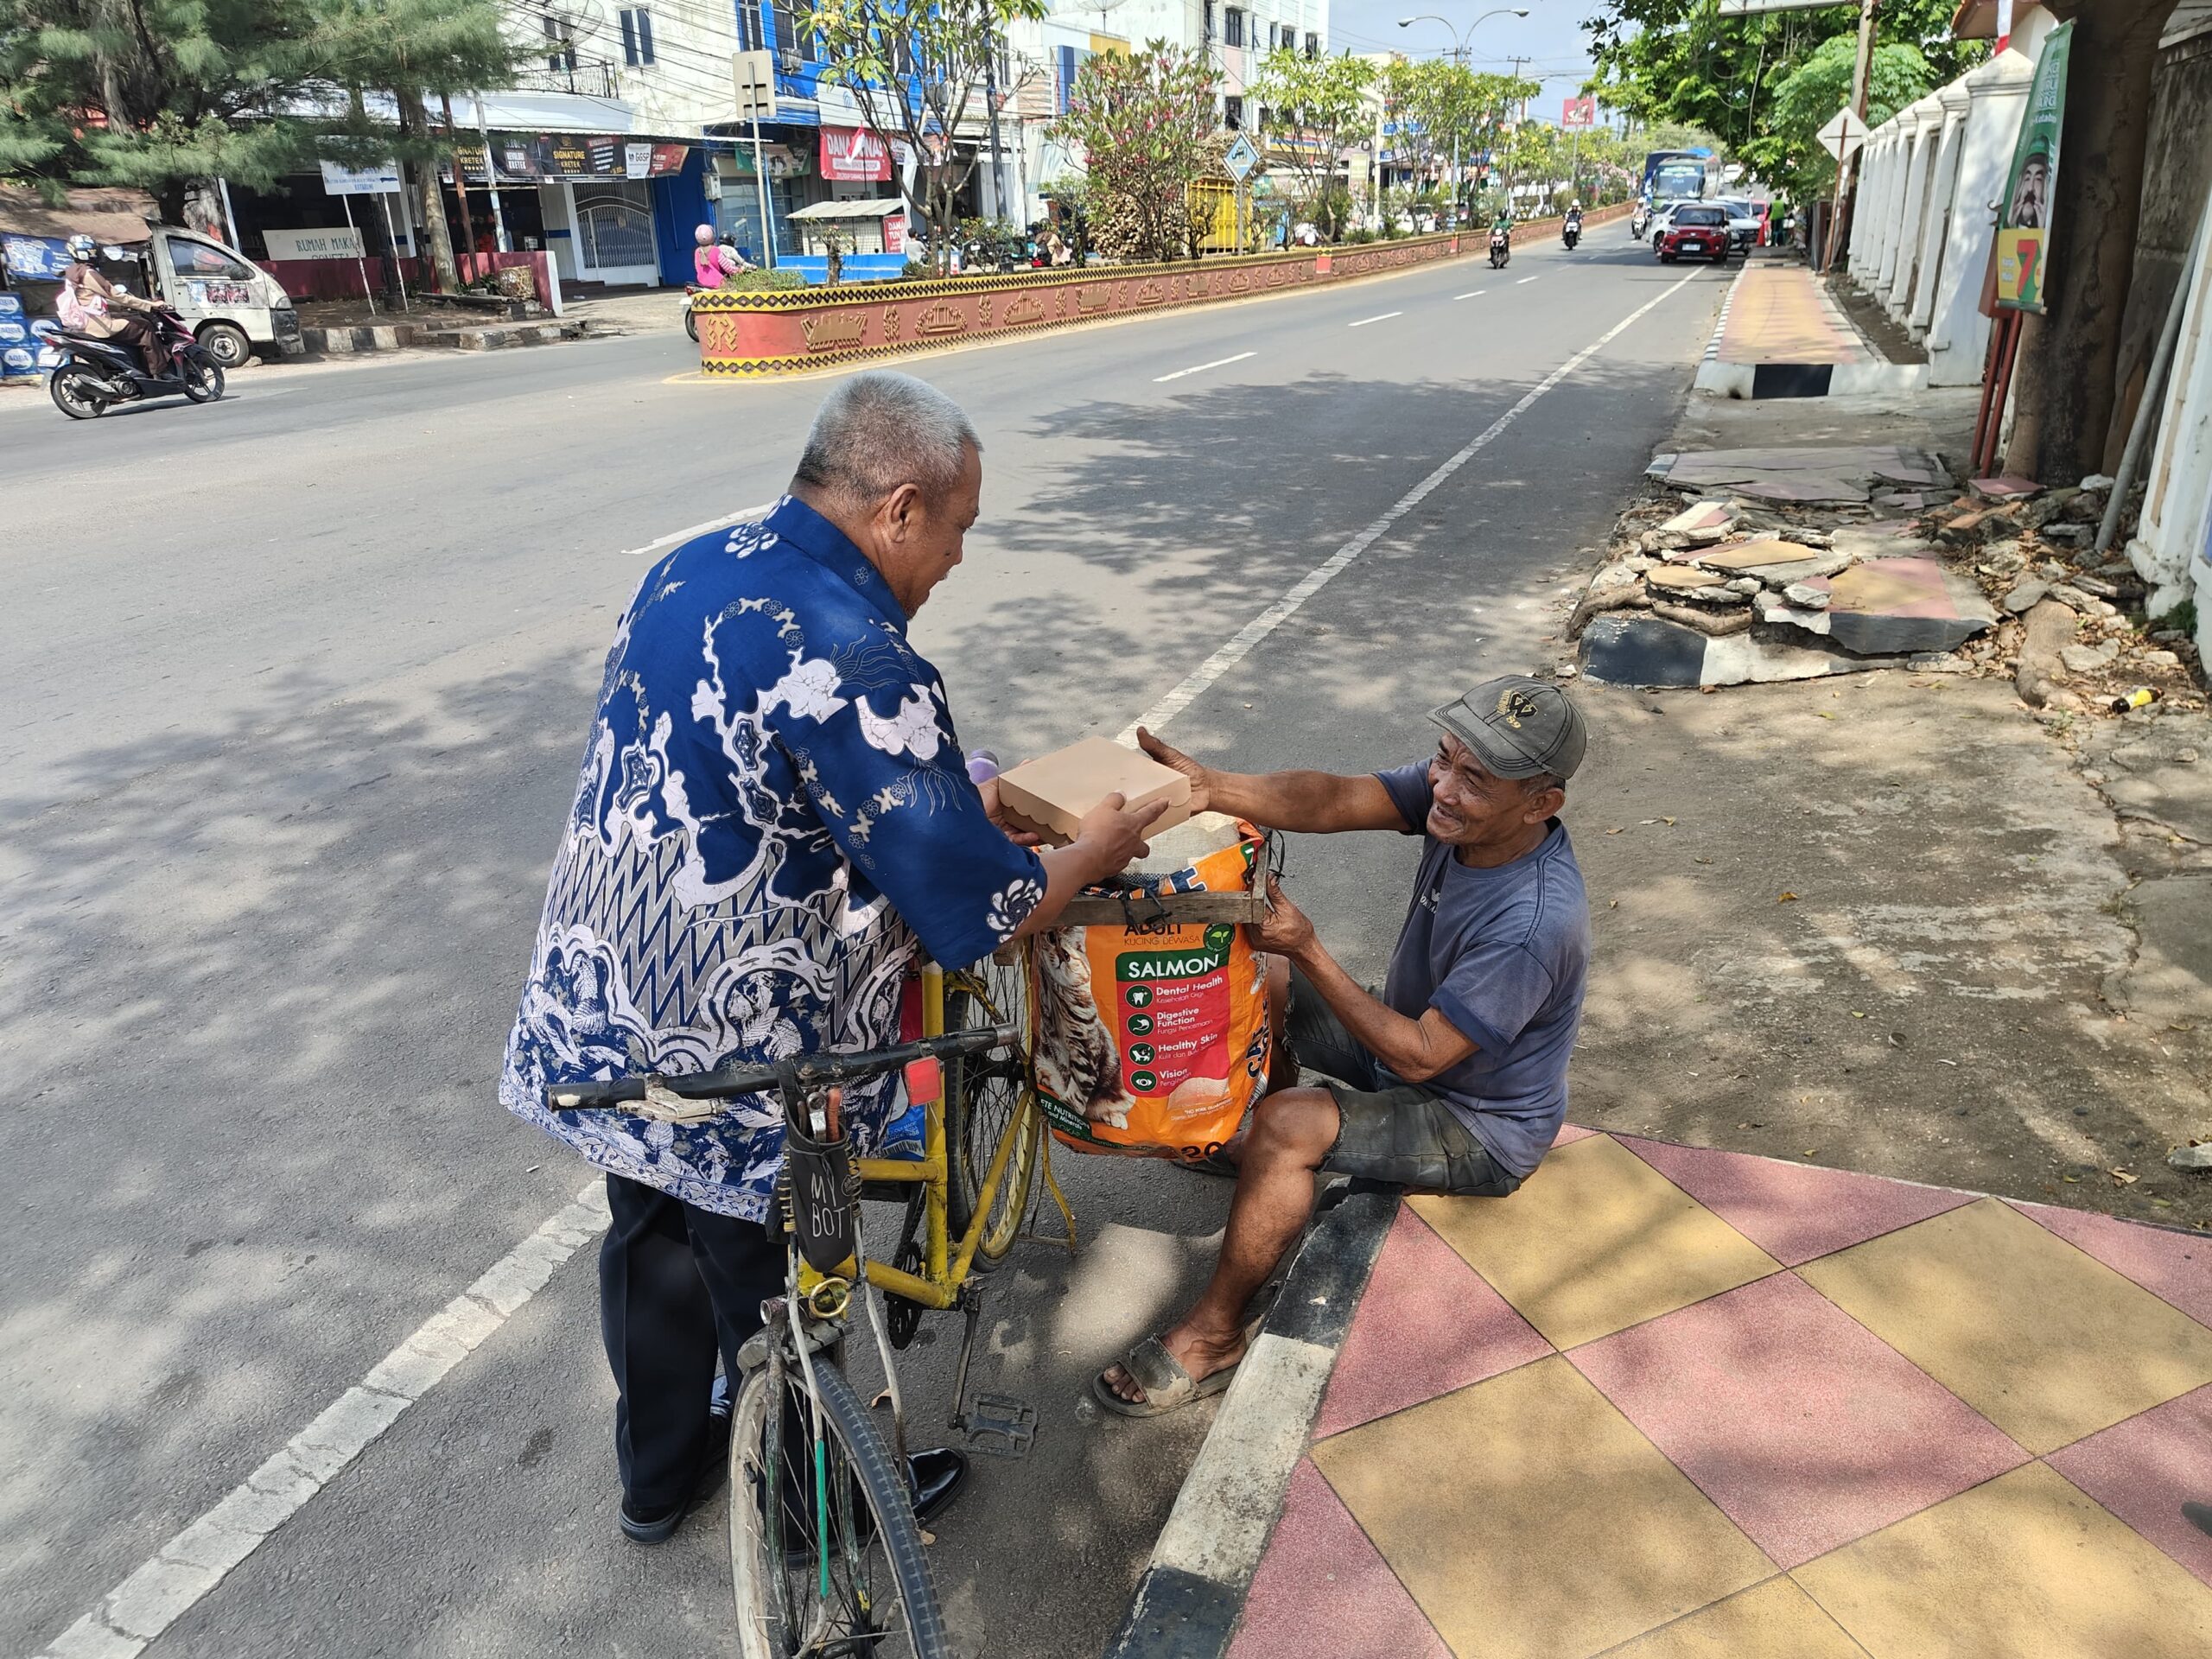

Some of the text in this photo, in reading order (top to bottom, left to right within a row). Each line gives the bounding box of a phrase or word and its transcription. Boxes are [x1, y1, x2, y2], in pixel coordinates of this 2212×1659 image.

[553, 150, 586, 160] SIGNATURE
[296, 238, 327, 252] RUMAH
[2016, 239, 2039, 297] 7
[1124, 935, 1200, 946] KUCING DEWASA
[1128, 954, 1219, 978] SALMON
[1156, 976, 1224, 995] Dental Health
[1157, 1007, 1199, 1020] Digestive
[1157, 1016, 1195, 1027] Function
[1158, 1033, 1218, 1052] Healthy Skin
[1159, 1068, 1188, 1079] Vision
[1059, 1115, 1083, 1130] Minerals
[810, 1173, 837, 1207] MY
